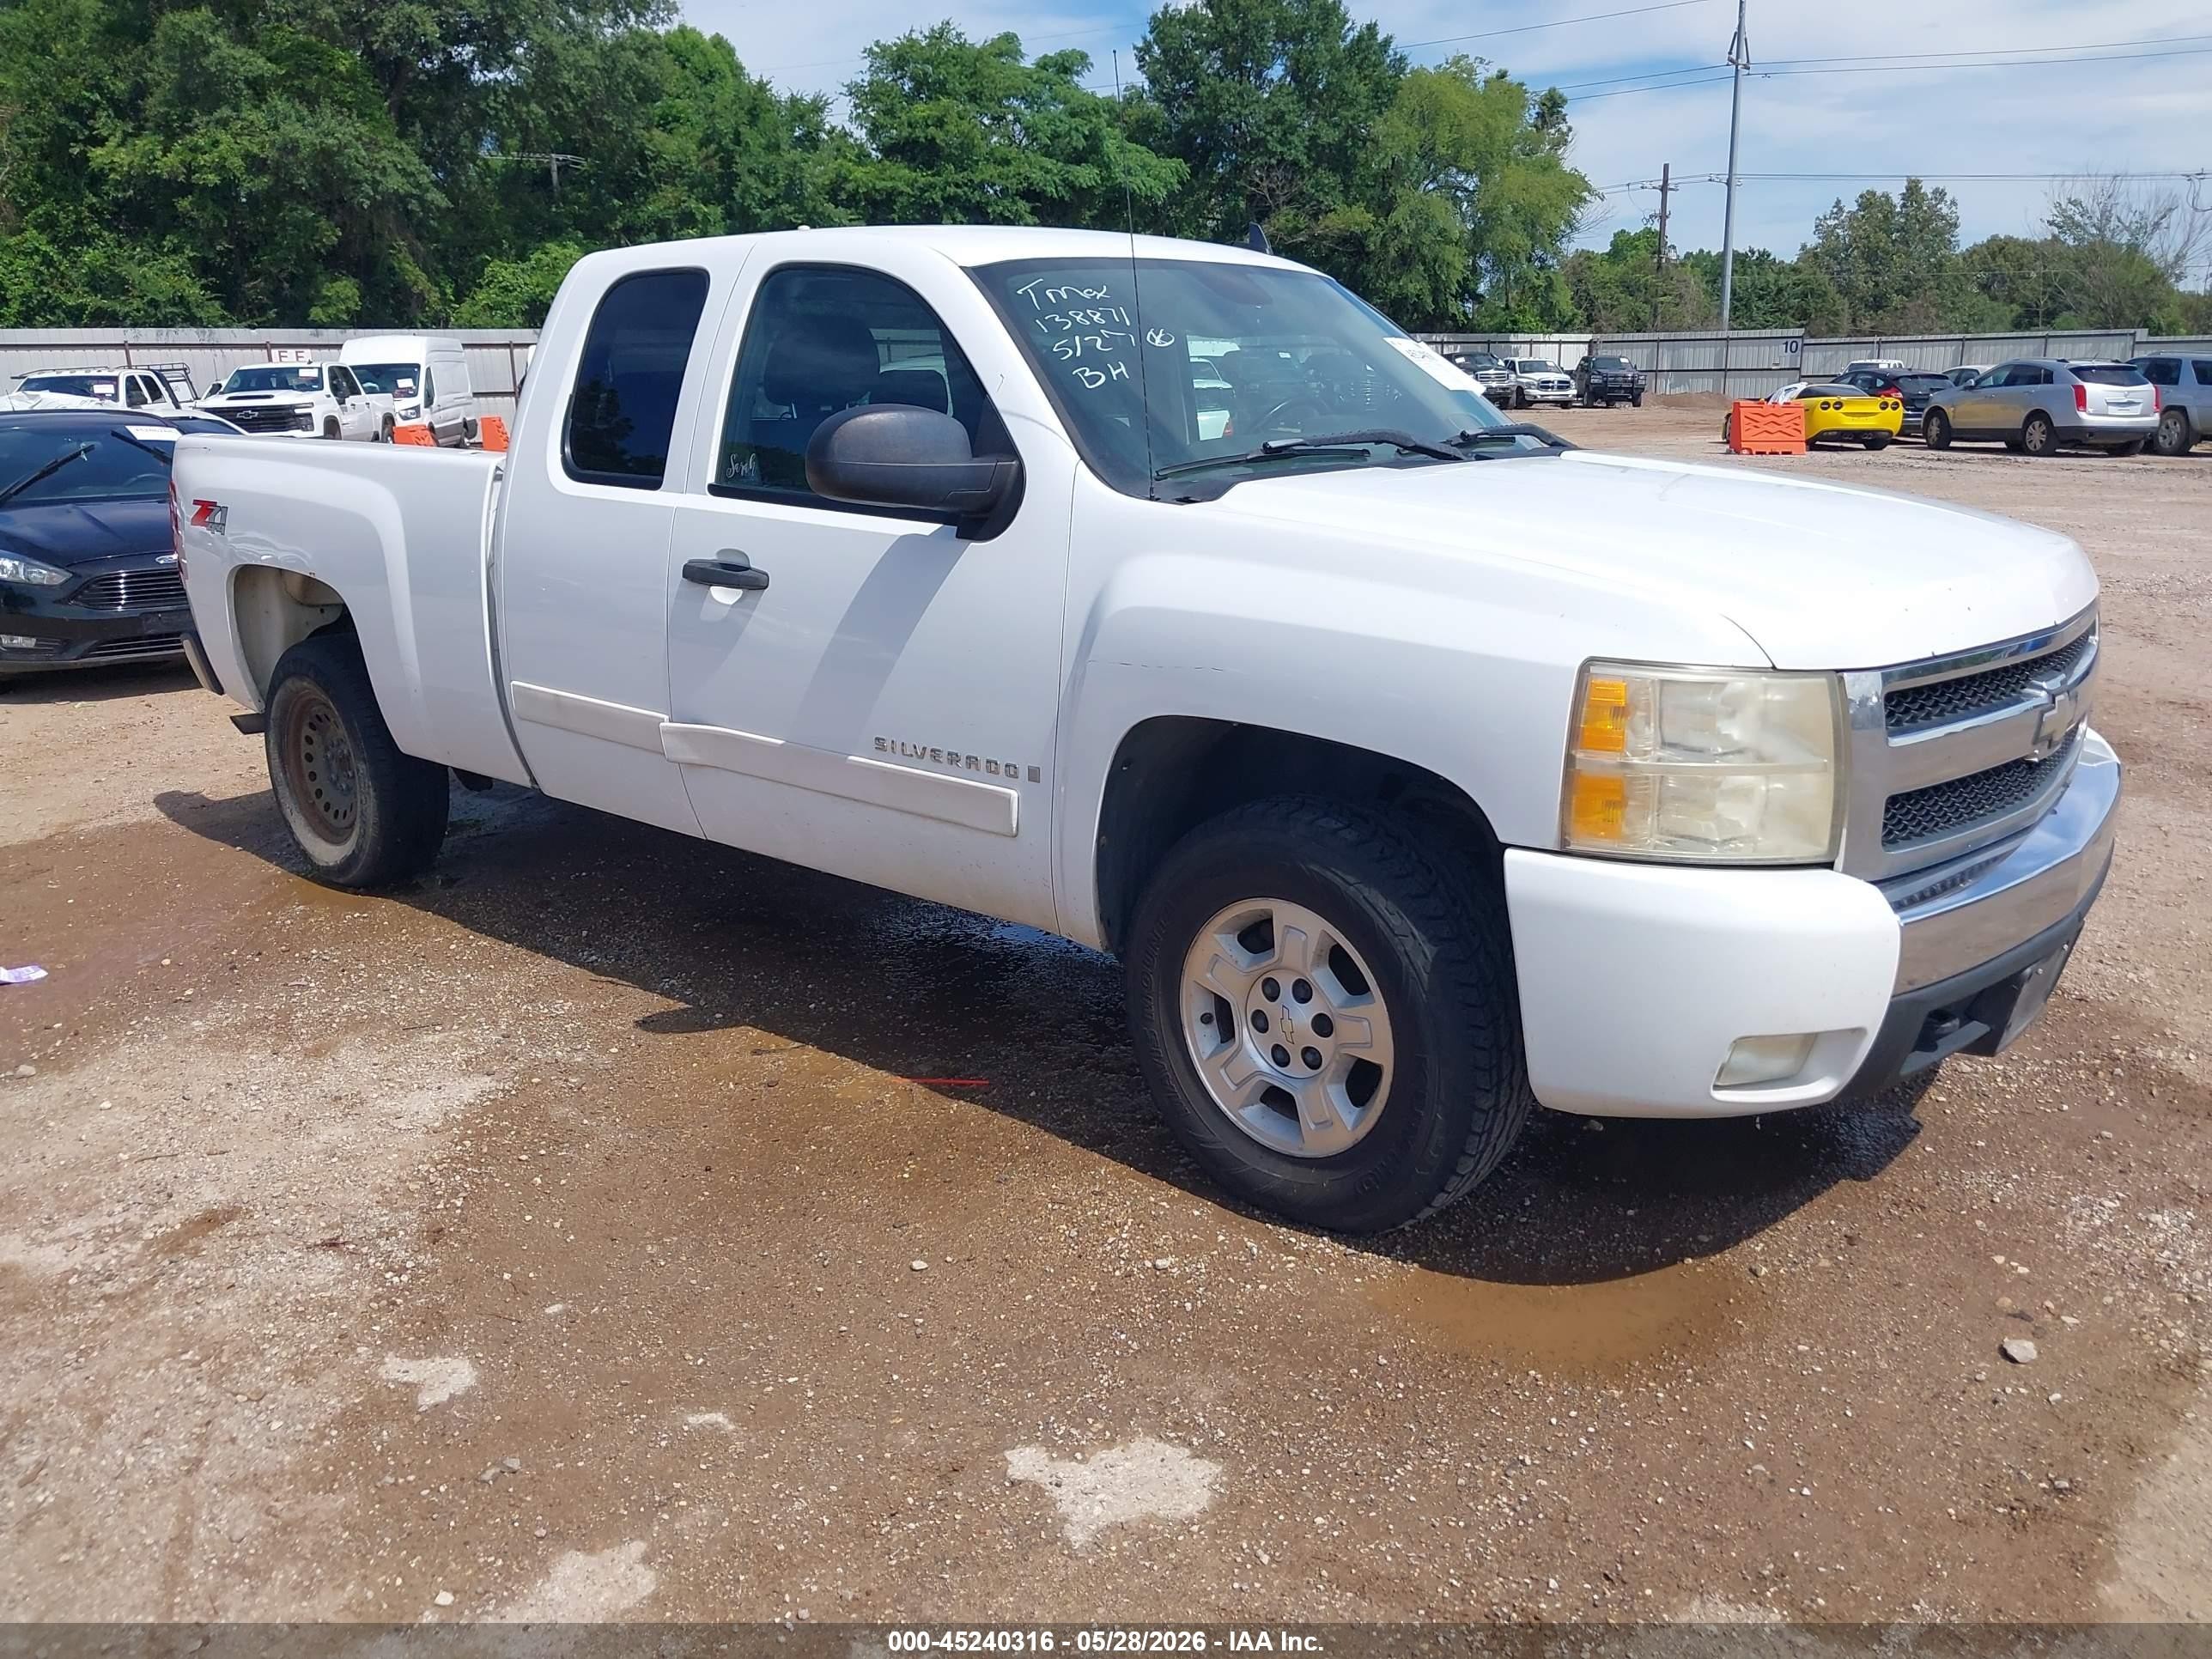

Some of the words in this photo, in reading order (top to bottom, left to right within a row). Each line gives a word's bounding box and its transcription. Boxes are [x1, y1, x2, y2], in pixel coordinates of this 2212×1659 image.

[1036, 307, 1130, 333] 138871
[1783, 340, 1799, 353] 10
[1073, 362, 1130, 388] BH
[726, 453, 757, 478] Sarah
[191, 499, 228, 526] Z71
[874, 736, 1020, 779] SILVERADO
